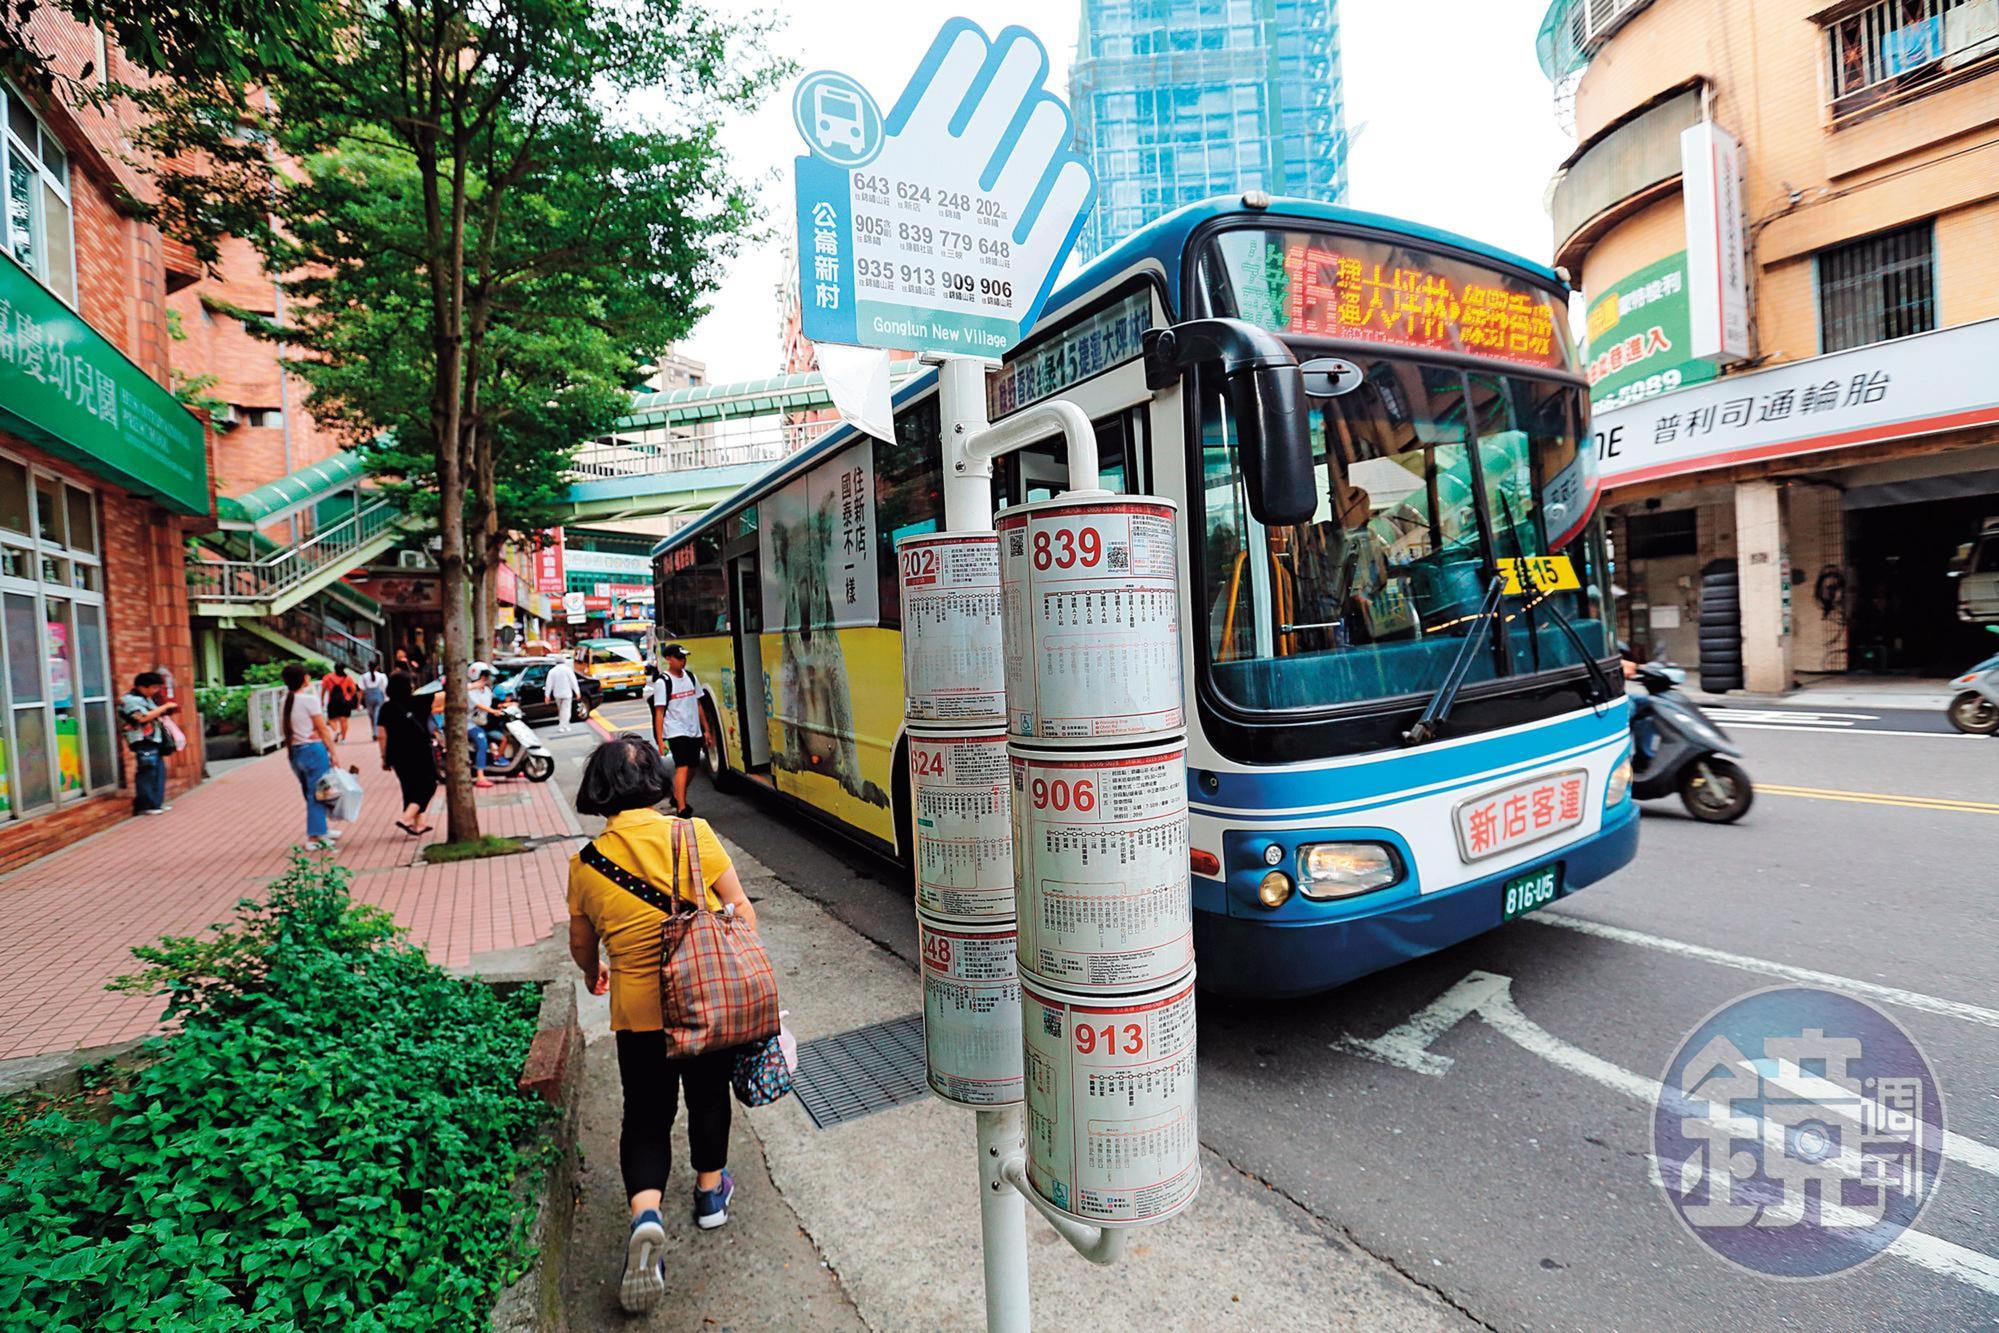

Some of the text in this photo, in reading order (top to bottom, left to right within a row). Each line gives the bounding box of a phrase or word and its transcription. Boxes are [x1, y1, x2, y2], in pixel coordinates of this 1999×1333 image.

[853, 172, 890, 195] 643
[897, 181, 931, 204] 624
[937, 190, 971, 211] 248
[899, 222, 933, 244] 839
[939, 229, 973, 251] 779
[978, 237, 1010, 259] 648
[857, 258, 1012, 298] 935 913 909 906
[873, 316, 1007, 348] Gonglun New Village
[1653, 369, 1891, 446] 普利司通輪胎
[902, 549, 935, 577] 202
[1033, 526, 1102, 571] 839
[1032, 777, 1095, 812] 906
[1469, 779, 1581, 853] 新店客運
[922, 935, 951, 963] 48
[1075, 1023, 1144, 1056] 913
